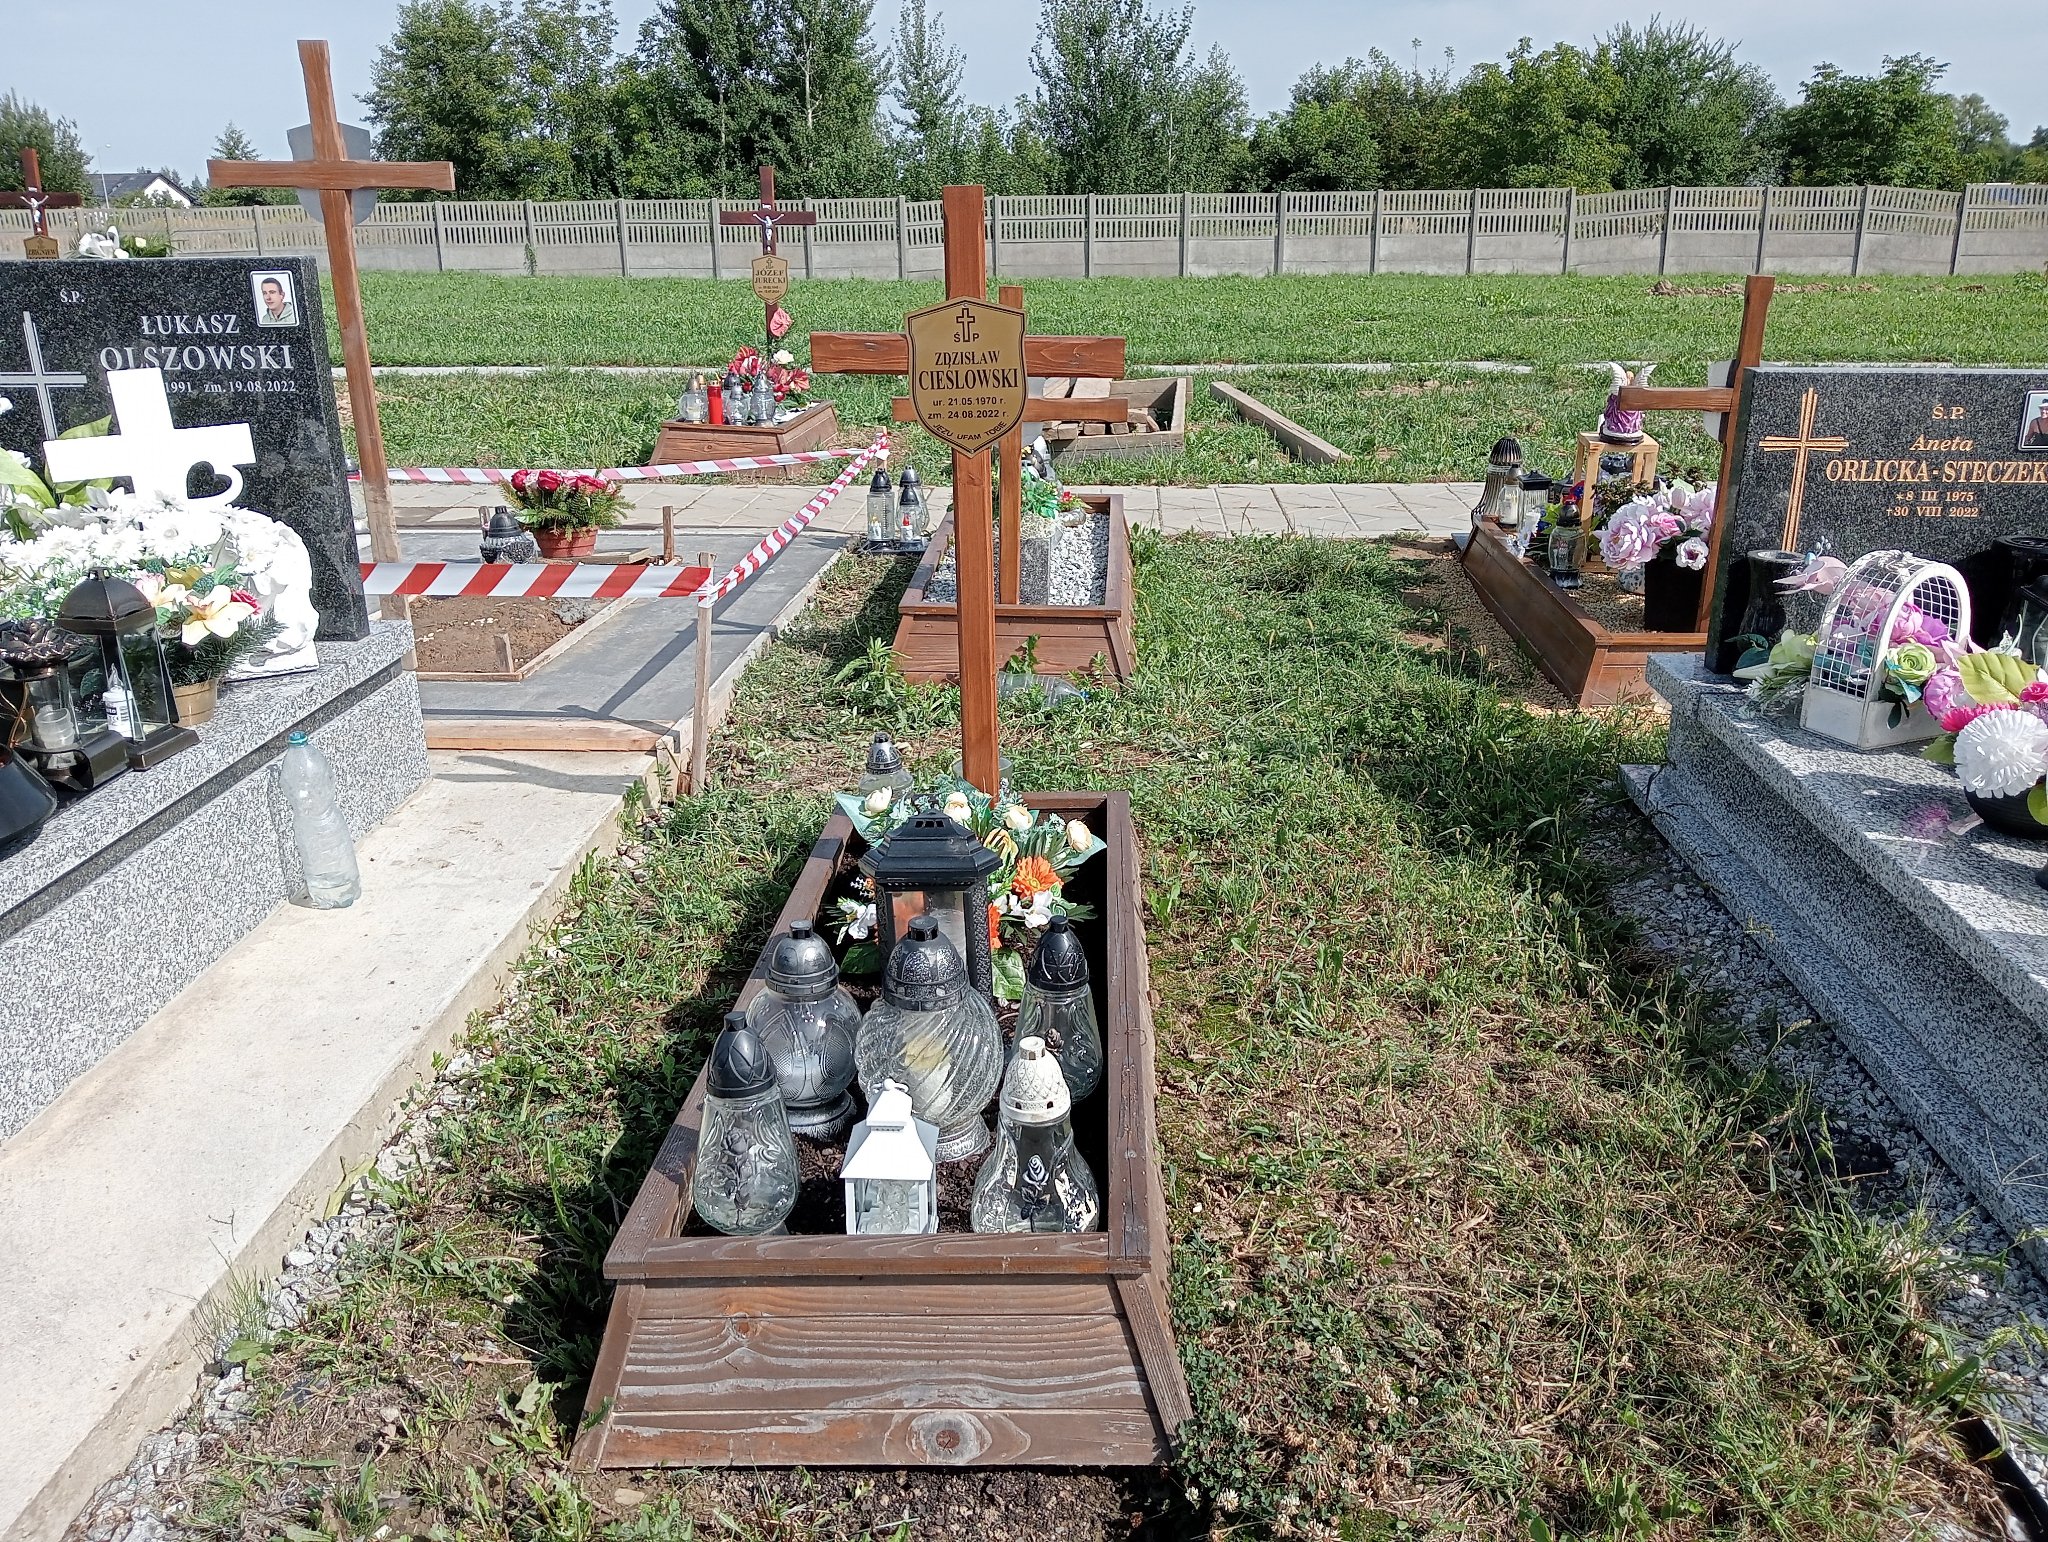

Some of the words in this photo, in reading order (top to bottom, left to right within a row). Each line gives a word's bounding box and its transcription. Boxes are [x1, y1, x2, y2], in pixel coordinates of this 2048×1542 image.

[140, 314, 240, 335] ŁUKASZ
[99, 344, 295, 371] OLSZOWSKI
[934, 350, 1000, 366] ZDZISŁAW
[918, 366, 1019, 391] CIEŚLOWSKI
[203, 382, 225, 394] zm.
[228, 380, 297, 393] 19.08.2022
[947, 396, 998, 407] 21.05.1970
[927, 412, 945, 420] zm.
[947, 409, 1000, 419] 24.08.2022
[933, 423, 954, 437] JEZU
[956, 433, 982, 441] UFAM
[984, 420, 1008, 437] TOBIE
[1909, 433, 1975, 452] Aneta
[1920, 490, 1939, 502] III
[1945, 491, 1975, 502] 1975
[1916, 506, 1944, 517] VIII
[1948, 507, 1980, 518] 2022
